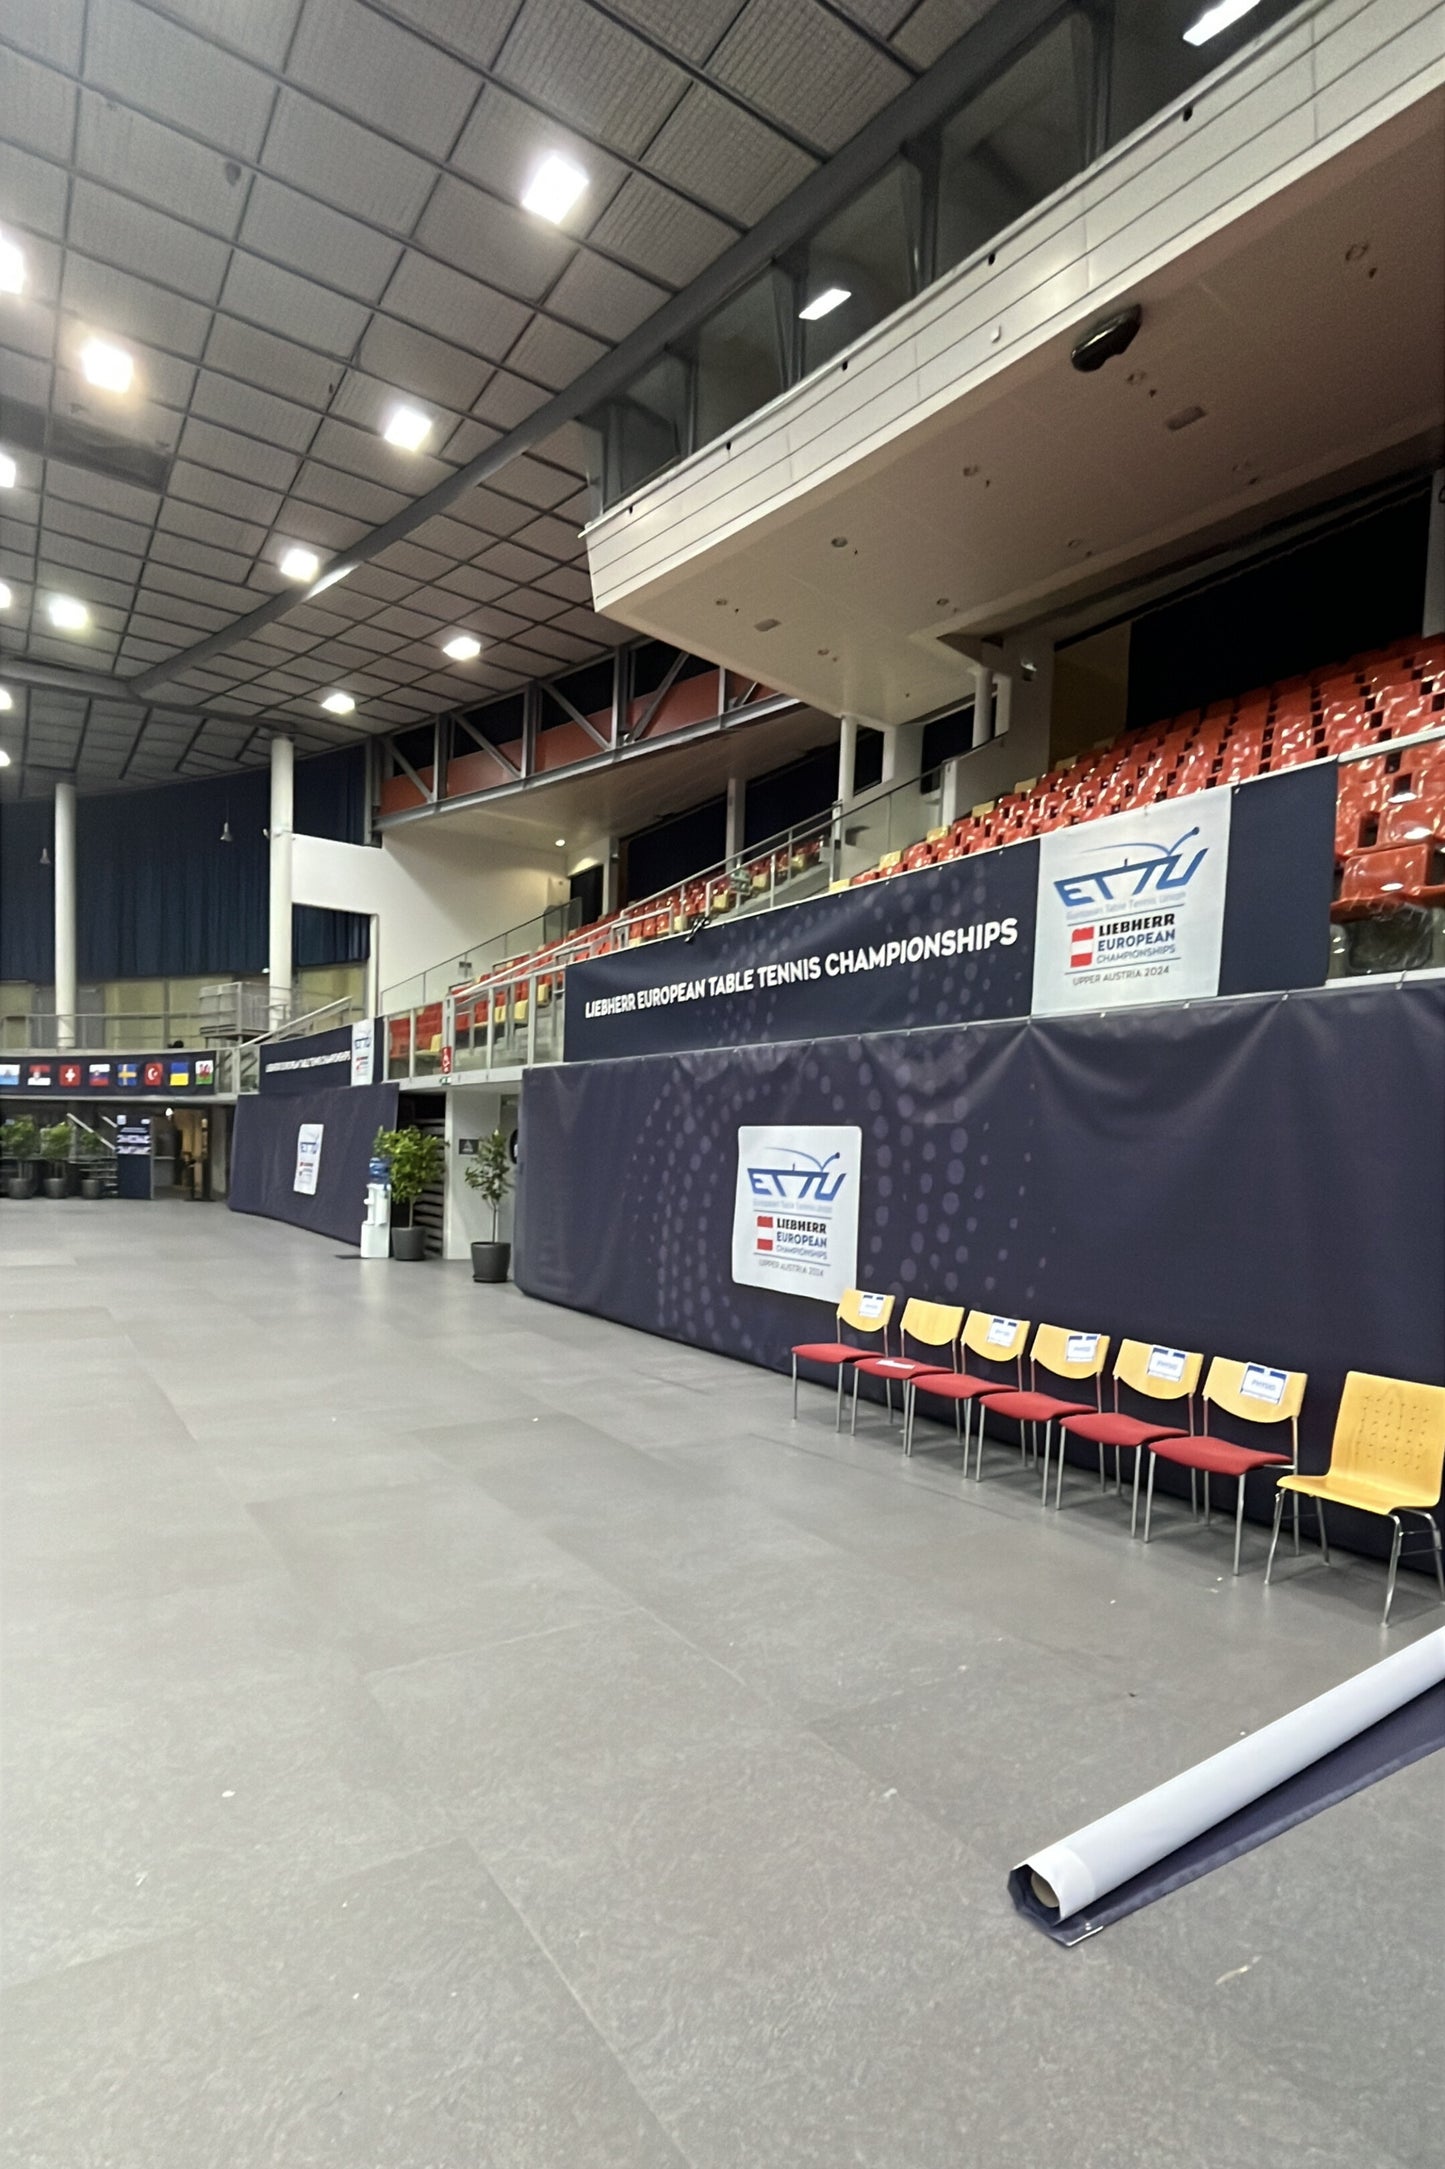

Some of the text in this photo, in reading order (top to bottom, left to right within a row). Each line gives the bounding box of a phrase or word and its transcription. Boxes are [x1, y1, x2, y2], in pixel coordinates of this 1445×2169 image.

[1054, 847, 1209, 907] ETTU
[1099, 913, 1176, 937] LIEBHERR
[1098, 929, 1176, 951] EUROPEAN
[1096, 944, 1176, 965] CHAMPIONSHIPS
[585, 917, 1019, 1018] LIEBHERR EUROPEAN TABLE TENNIS CHAMPIONSHIPS
[1073, 965, 1170, 986] UPPER AUSTRIA 2024
[747, 1168, 847, 1201] ETTU
[776, 1218, 827, 1234] LIEBHERR
[776, 1231, 828, 1249] EUROPEAN
